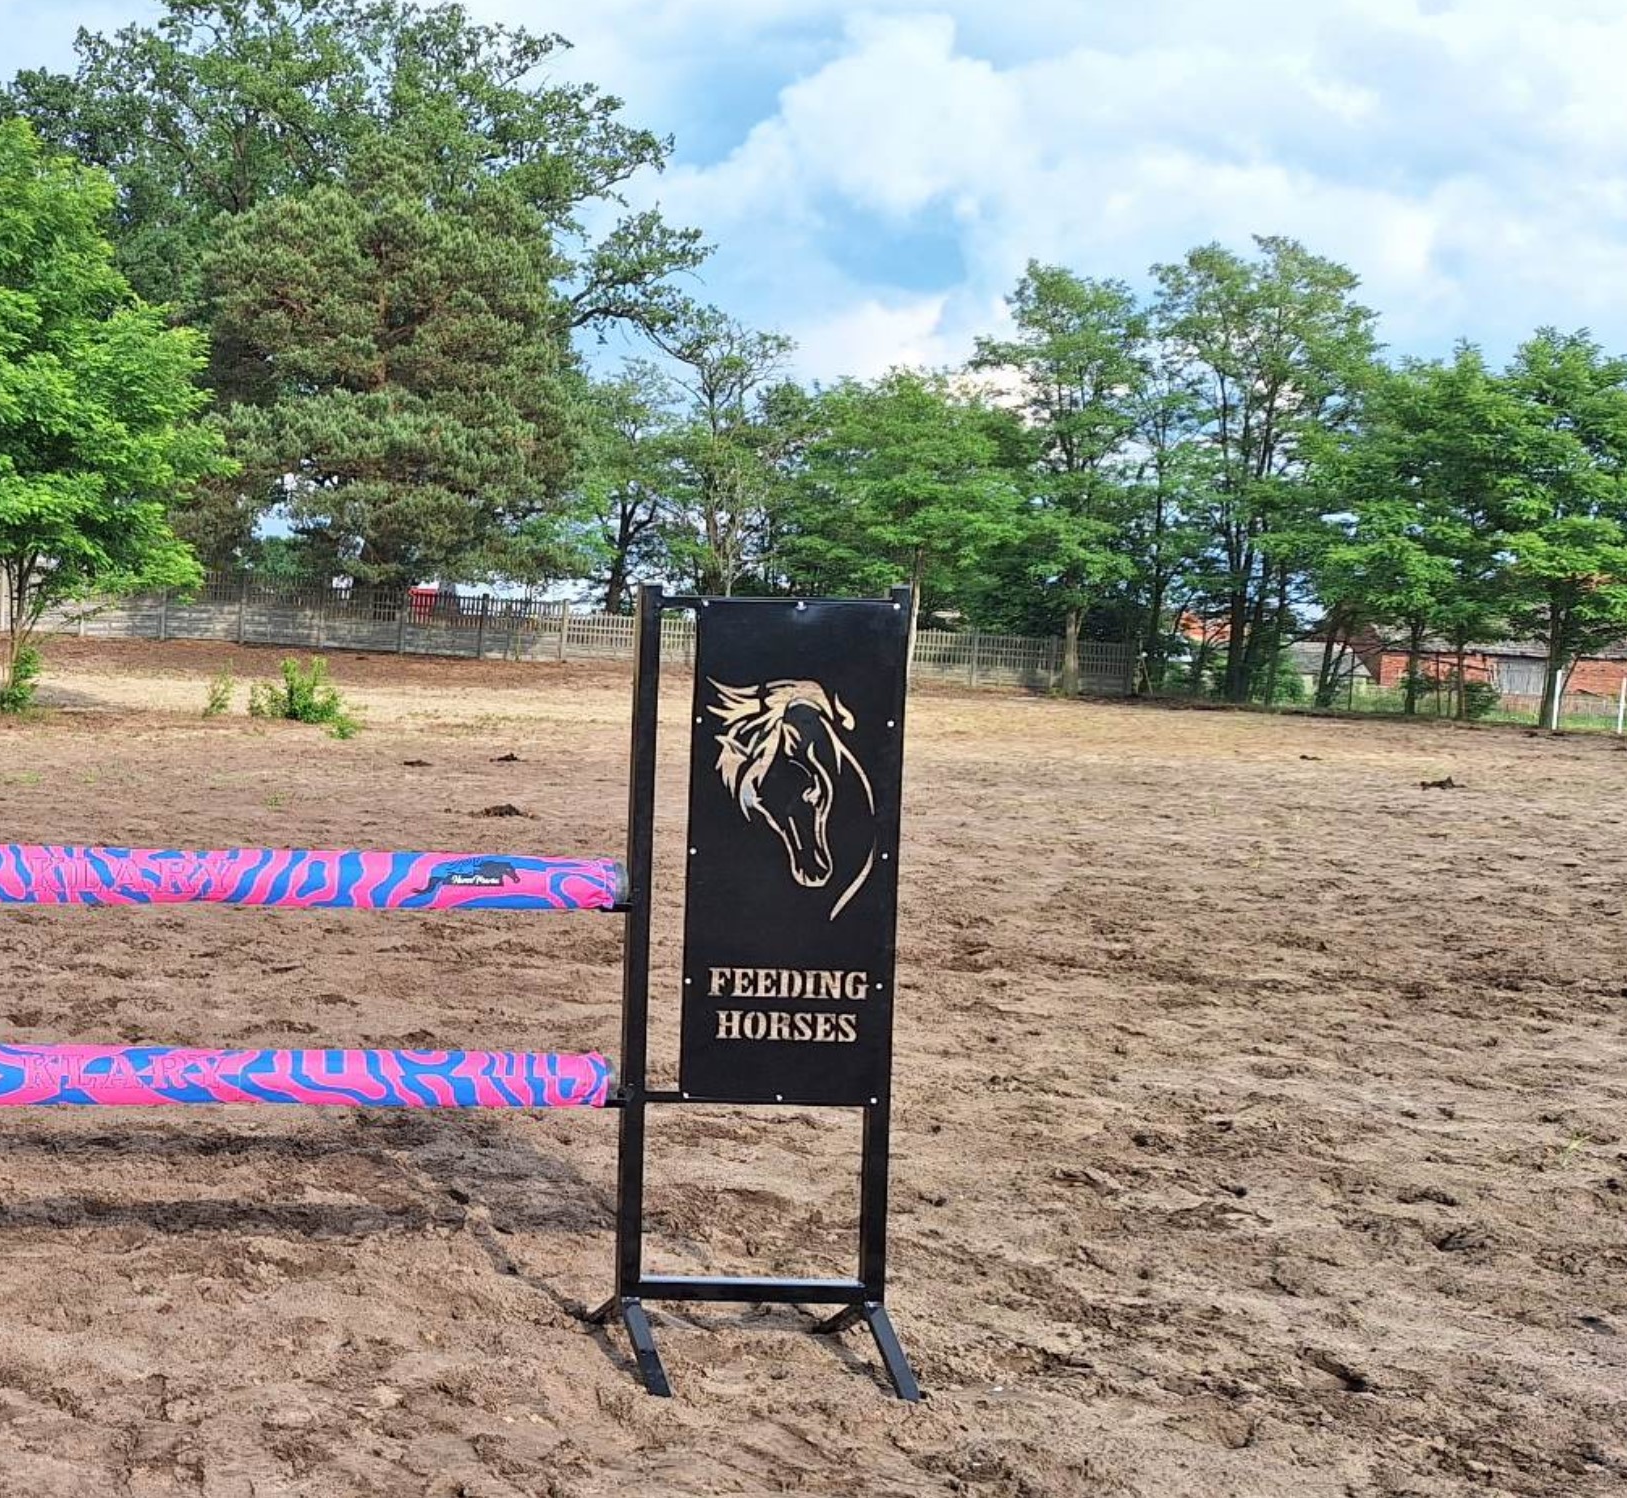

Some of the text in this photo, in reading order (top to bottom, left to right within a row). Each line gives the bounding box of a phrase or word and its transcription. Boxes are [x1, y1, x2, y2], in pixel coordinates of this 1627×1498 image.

[29, 856, 234, 893] KLARY
[707, 967, 869, 1000] FEEDING
[715, 1010, 858, 1042] HORSES
[23, 1055, 225, 1089] KLARY
